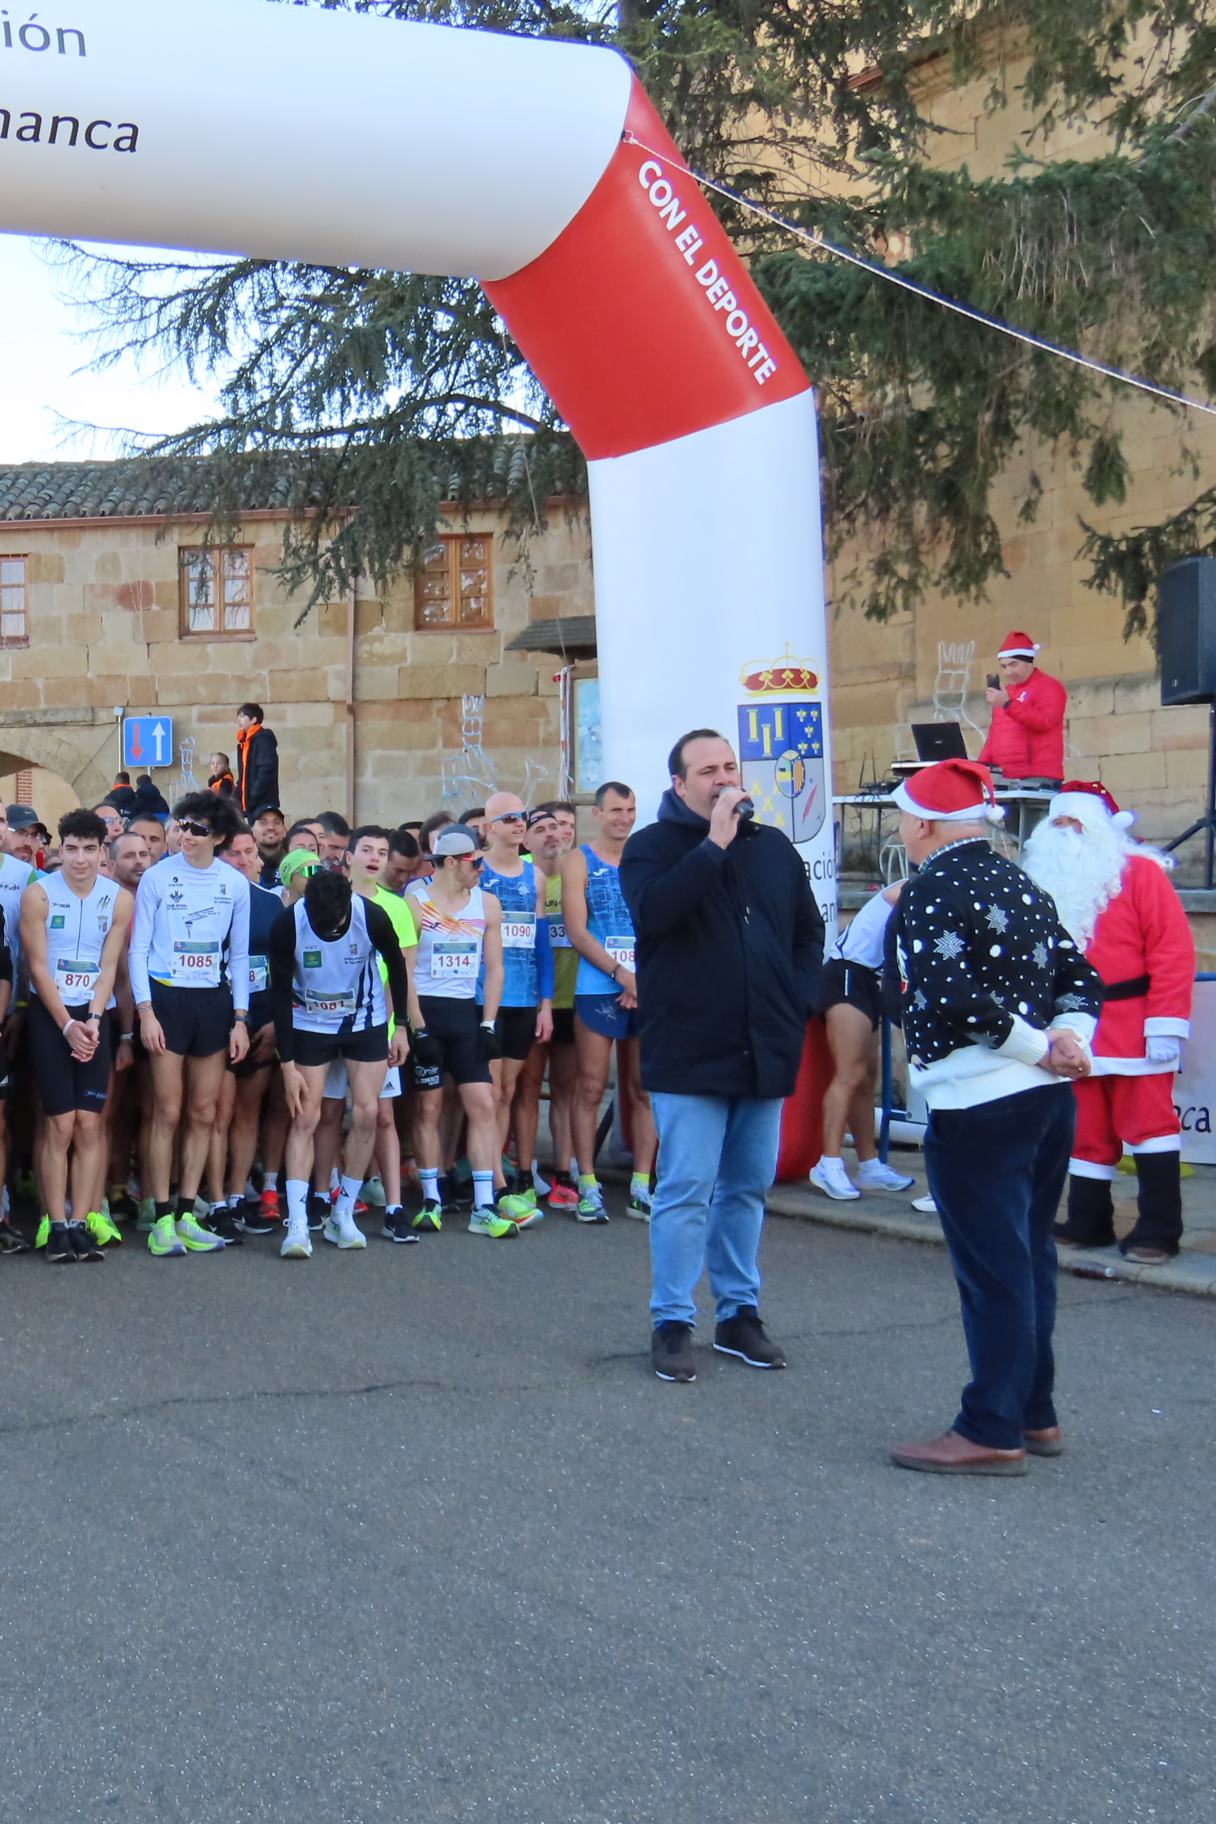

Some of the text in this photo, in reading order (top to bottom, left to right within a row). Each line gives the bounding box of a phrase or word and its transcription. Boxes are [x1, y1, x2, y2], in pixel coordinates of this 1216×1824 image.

[638, 160, 777, 386] CON EL DEPORTE
[503, 925, 531, 937] 1090
[178, 955, 213, 968] 1085
[438, 955, 471, 967] 1314
[65, 973, 90, 987] 870
